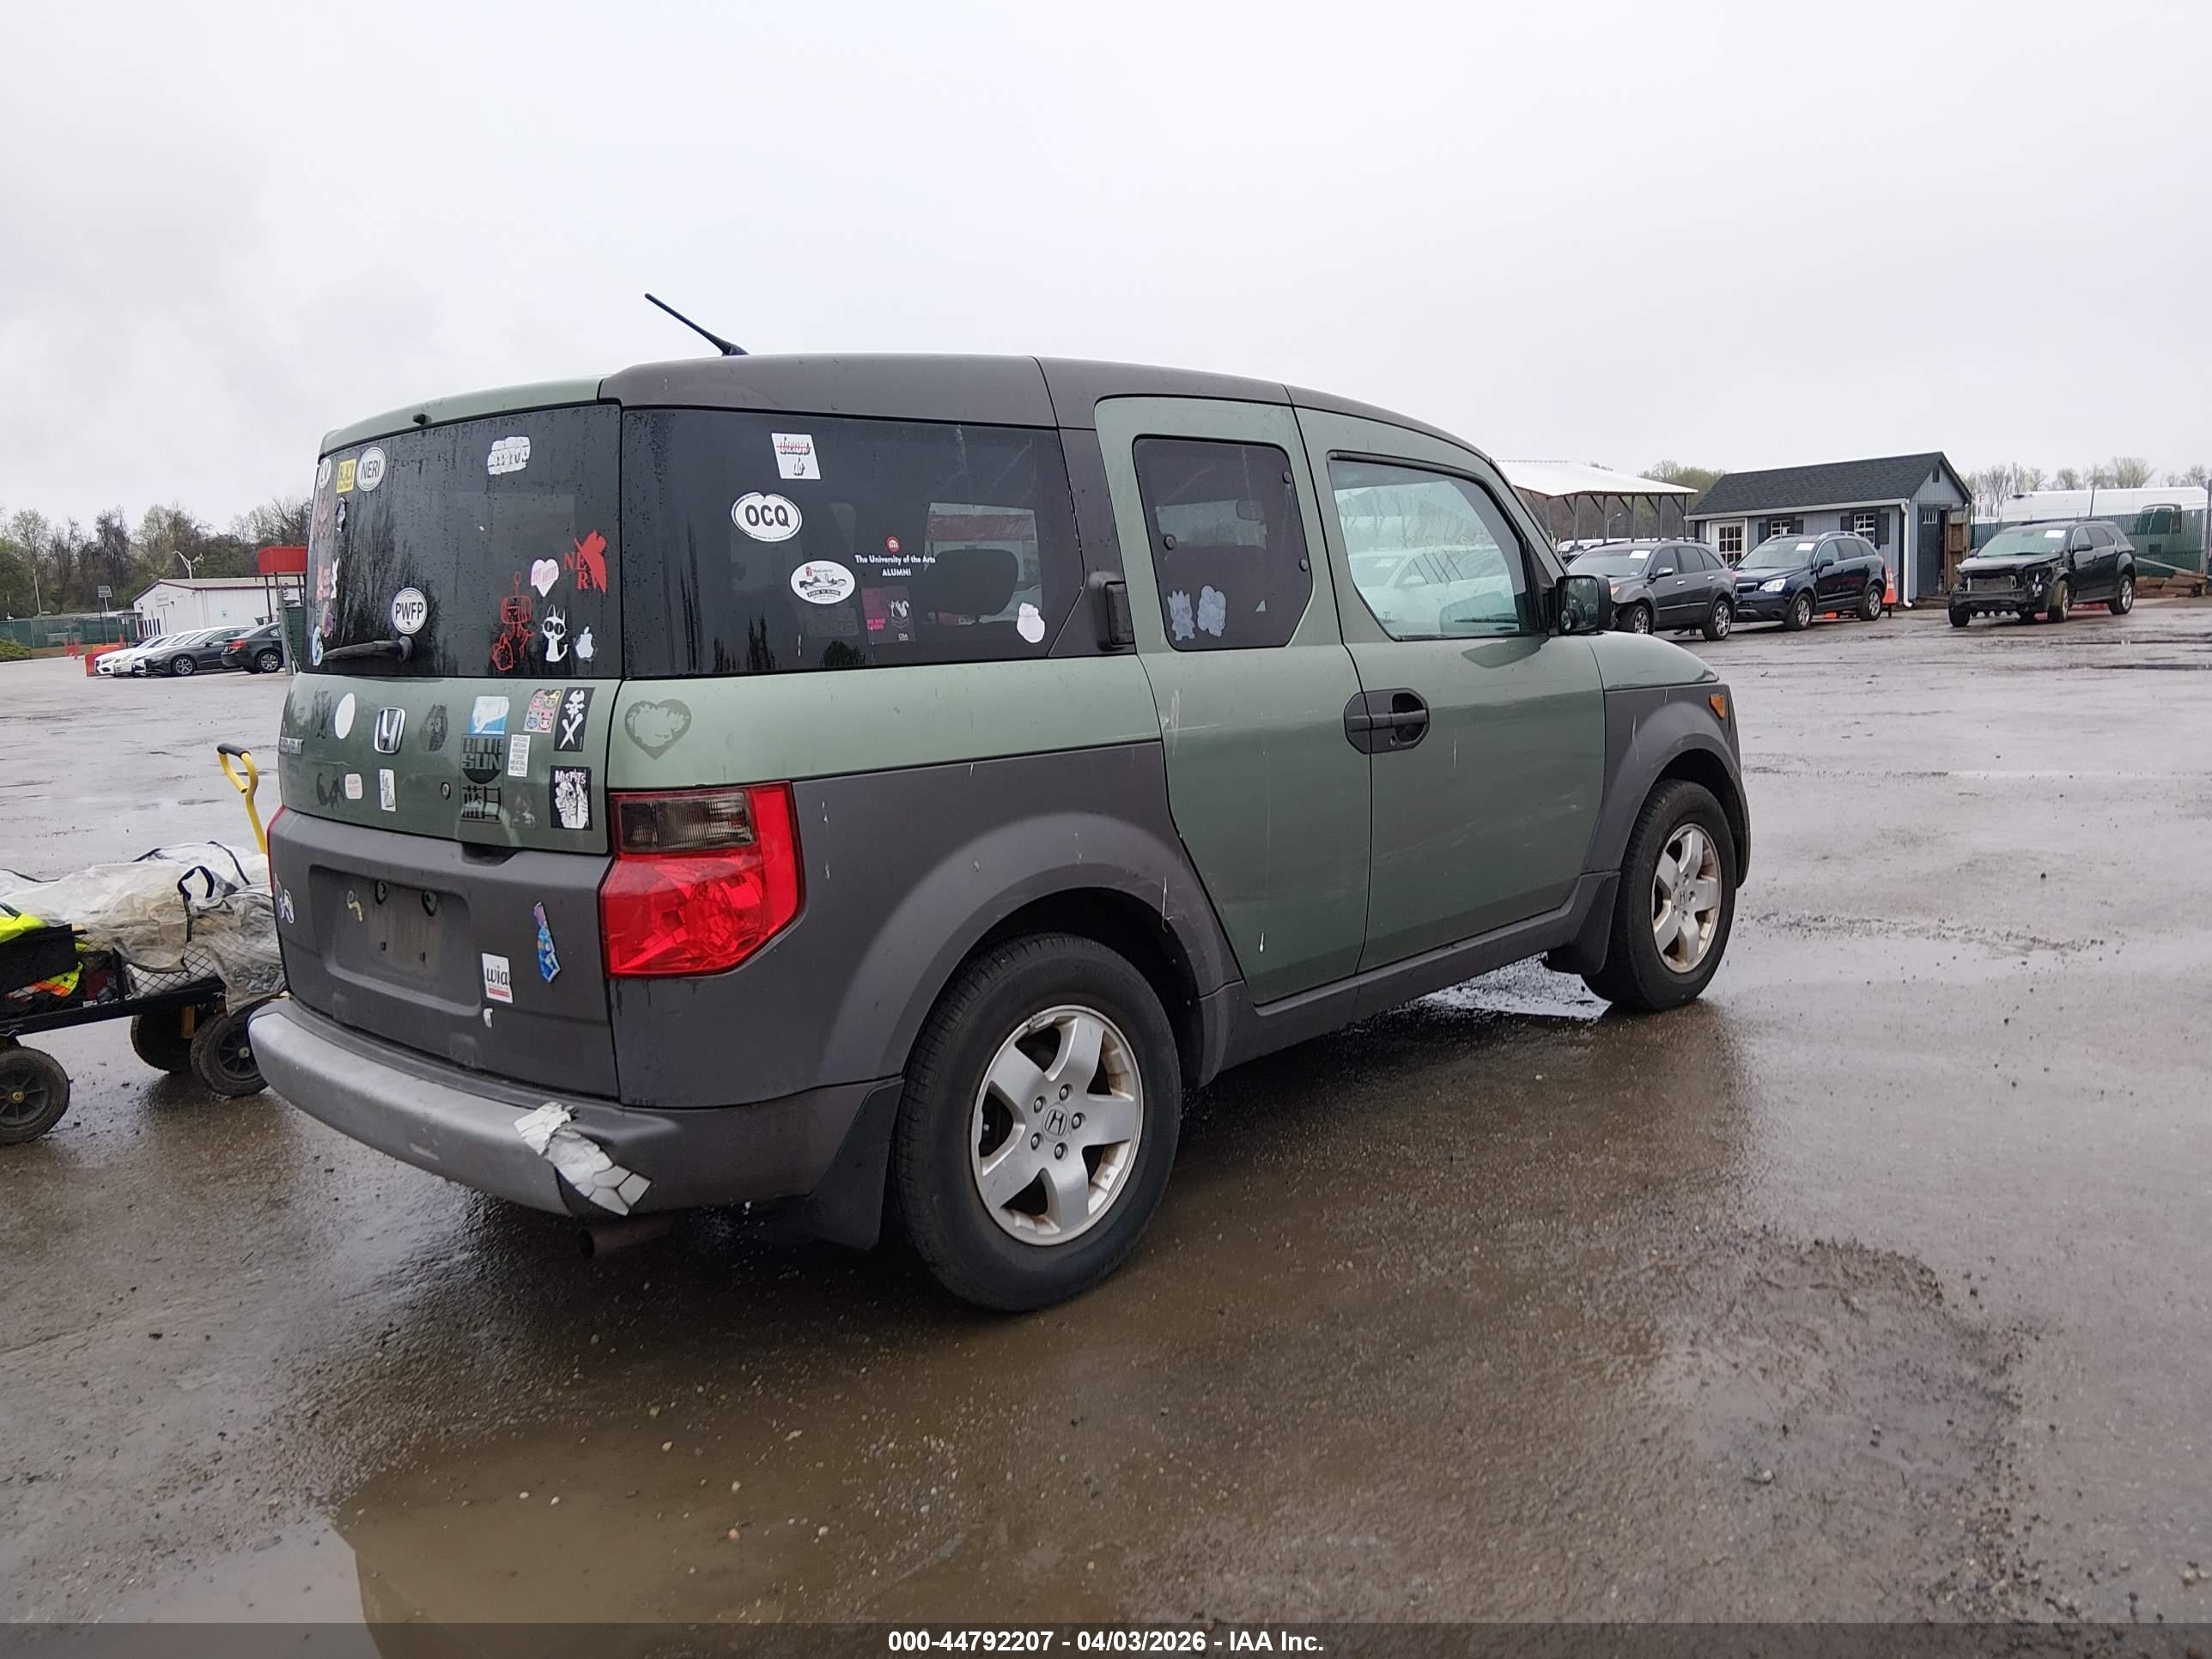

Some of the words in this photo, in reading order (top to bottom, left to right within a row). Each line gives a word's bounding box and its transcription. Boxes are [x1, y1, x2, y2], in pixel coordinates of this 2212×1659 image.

[361, 459, 381, 481] NERI
[744, 504, 790, 528] OCQ
[854, 554, 867, 564] The
[869, 554, 902, 566] University
[902, 554, 910, 563] of
[911, 554, 921, 563] the
[922, 554, 936, 564] Arts
[882, 568, 912, 577] ALUMNI
[395, 602, 424, 620] PWFP
[463, 738, 502, 754] BLUE
[462, 754, 502, 770] SUN
[486, 964, 508, 986] wia
